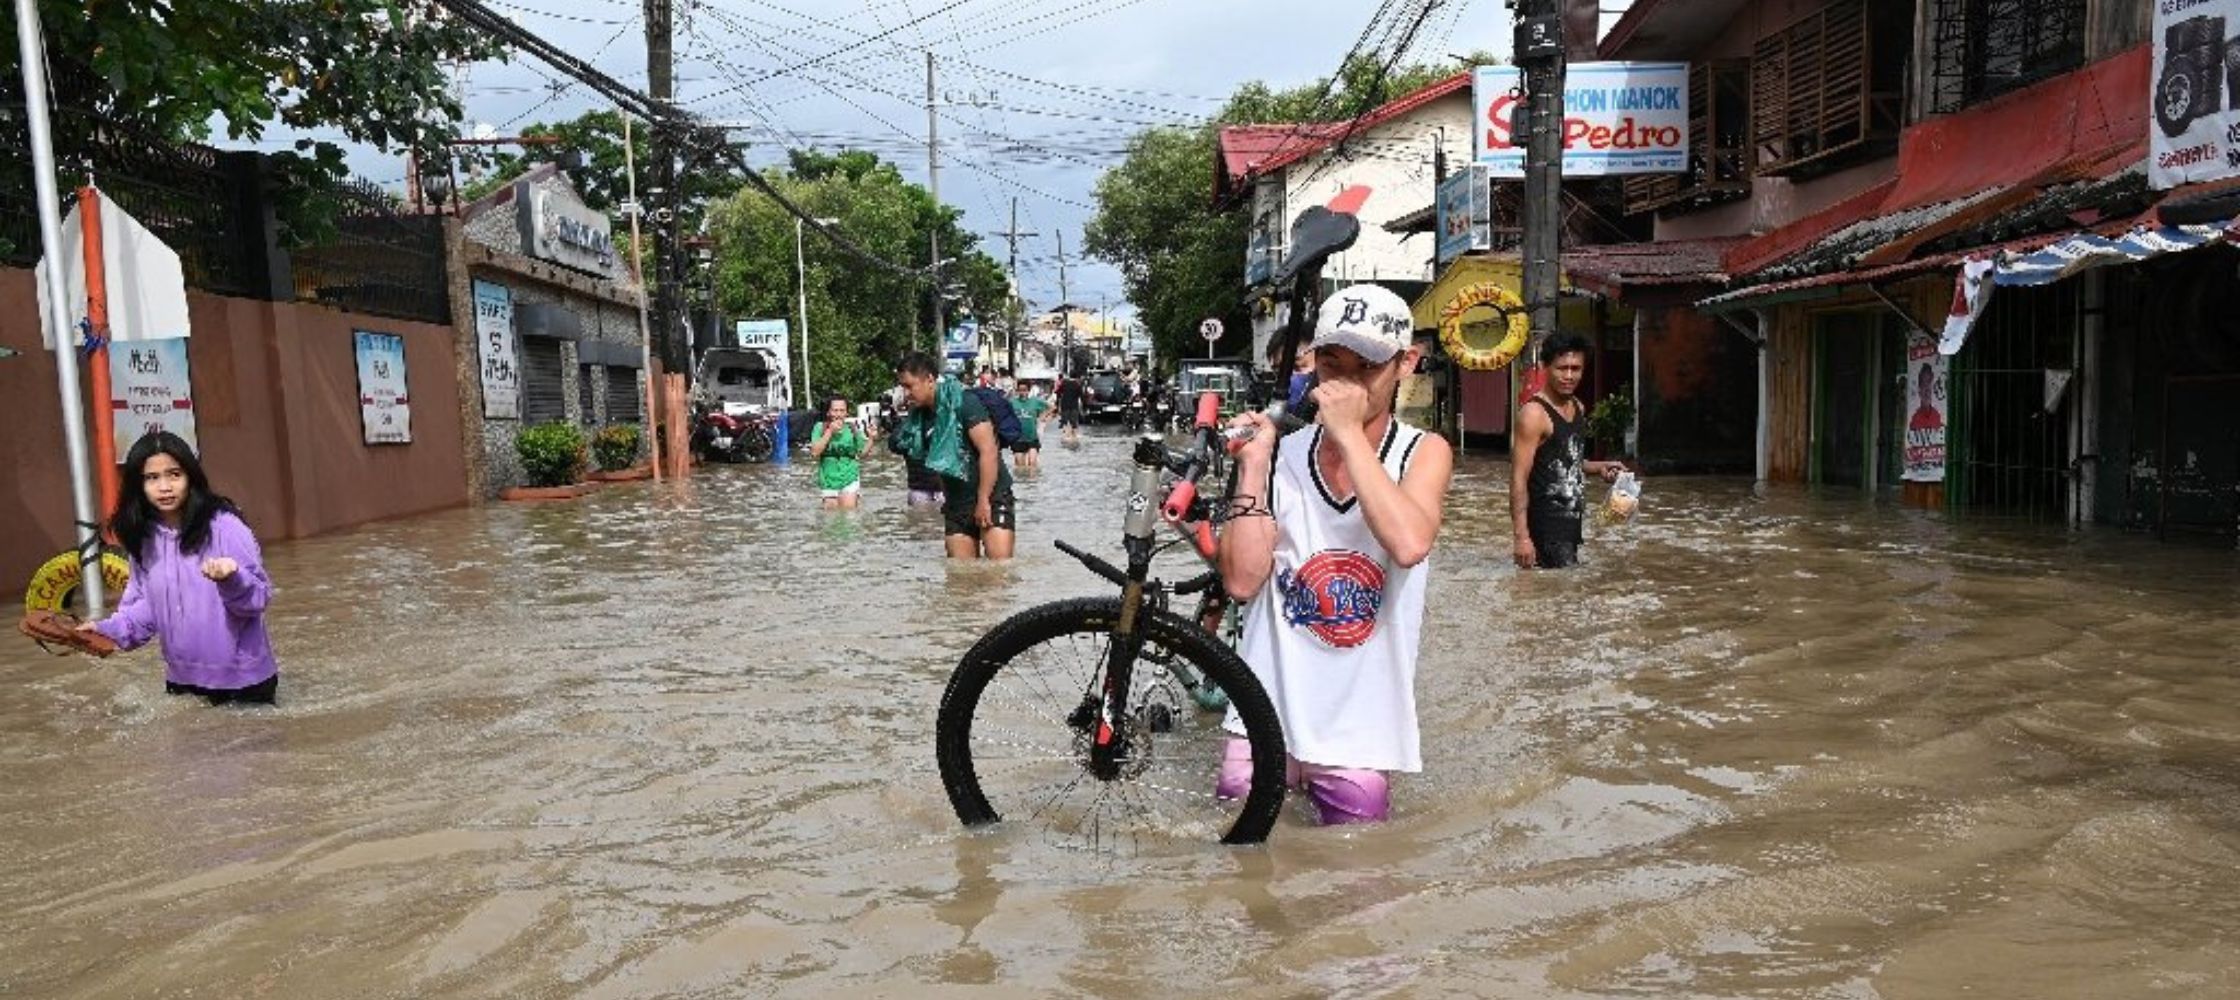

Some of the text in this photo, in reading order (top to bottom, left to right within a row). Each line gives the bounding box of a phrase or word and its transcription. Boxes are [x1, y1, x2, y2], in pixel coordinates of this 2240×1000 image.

[1566, 87, 1681, 112] HON MANOK
[1560, 118, 1681, 150] Pedro
